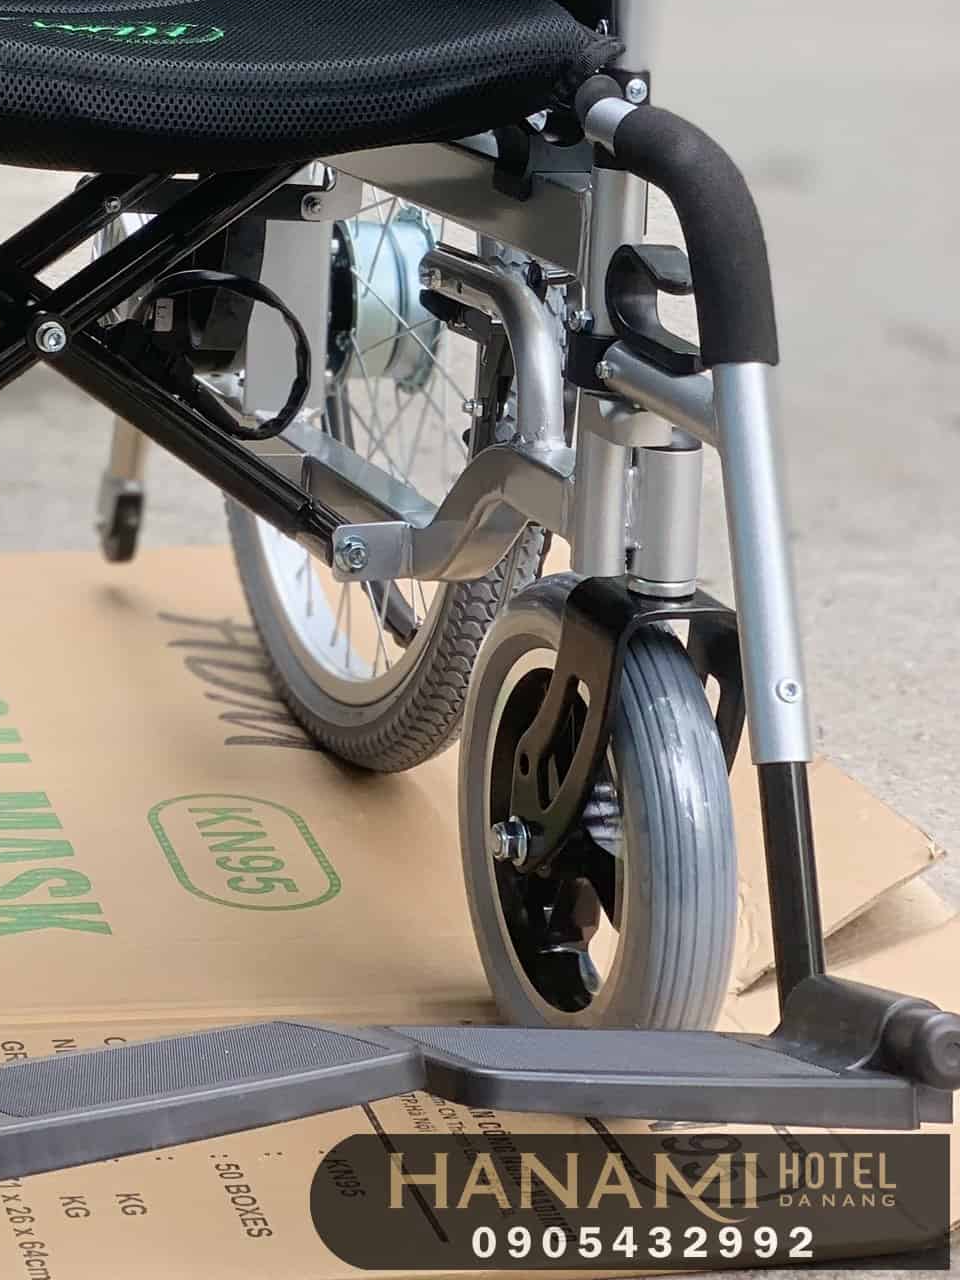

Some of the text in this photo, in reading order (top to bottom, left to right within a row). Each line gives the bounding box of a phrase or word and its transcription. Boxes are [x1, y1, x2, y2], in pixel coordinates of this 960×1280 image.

[187, 807, 301, 897] KN95
[6, 1207, 35, 1223] 26
[60, 1195, 90, 1218] KG
[116, 1193, 147, 1216] KG
[225, 1184, 272, 1238] BOXES
